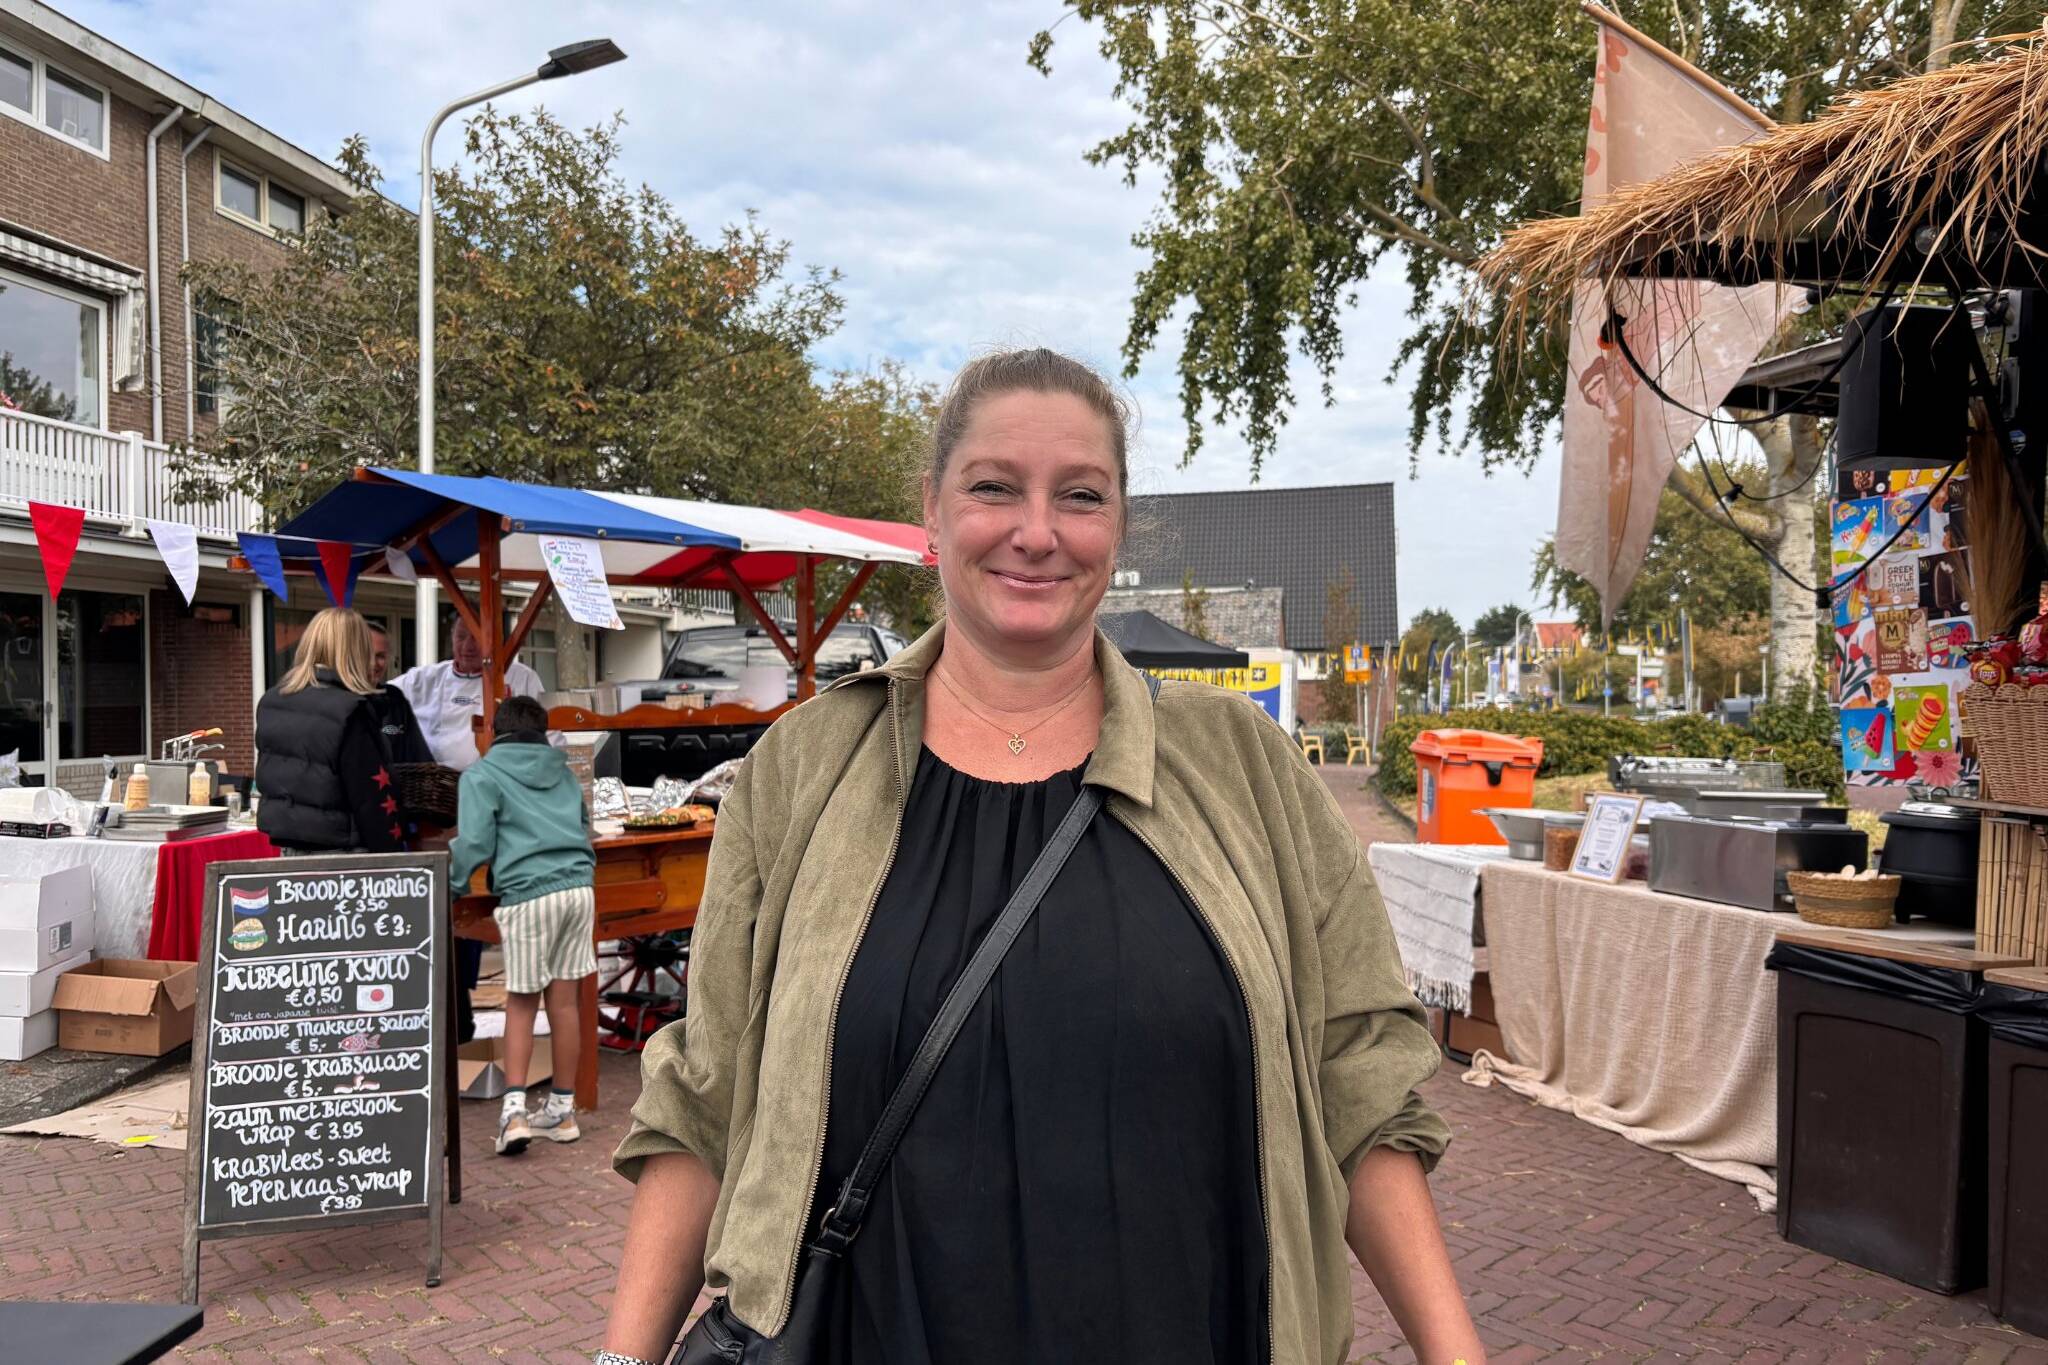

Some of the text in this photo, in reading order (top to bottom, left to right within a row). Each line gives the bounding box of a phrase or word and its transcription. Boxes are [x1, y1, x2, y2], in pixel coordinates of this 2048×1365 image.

[1887, 565, 1914, 574] GREEK
[1887, 573, 1914, 582] STYLE
[1886, 624, 1899, 638] M
[628, 733, 747, 752] RAM
[334, 899, 351, 914] €
[285, 1038, 301, 1054] €
[304, 1122, 323, 1140] €
[328, 1120, 363, 1140] 3.95
